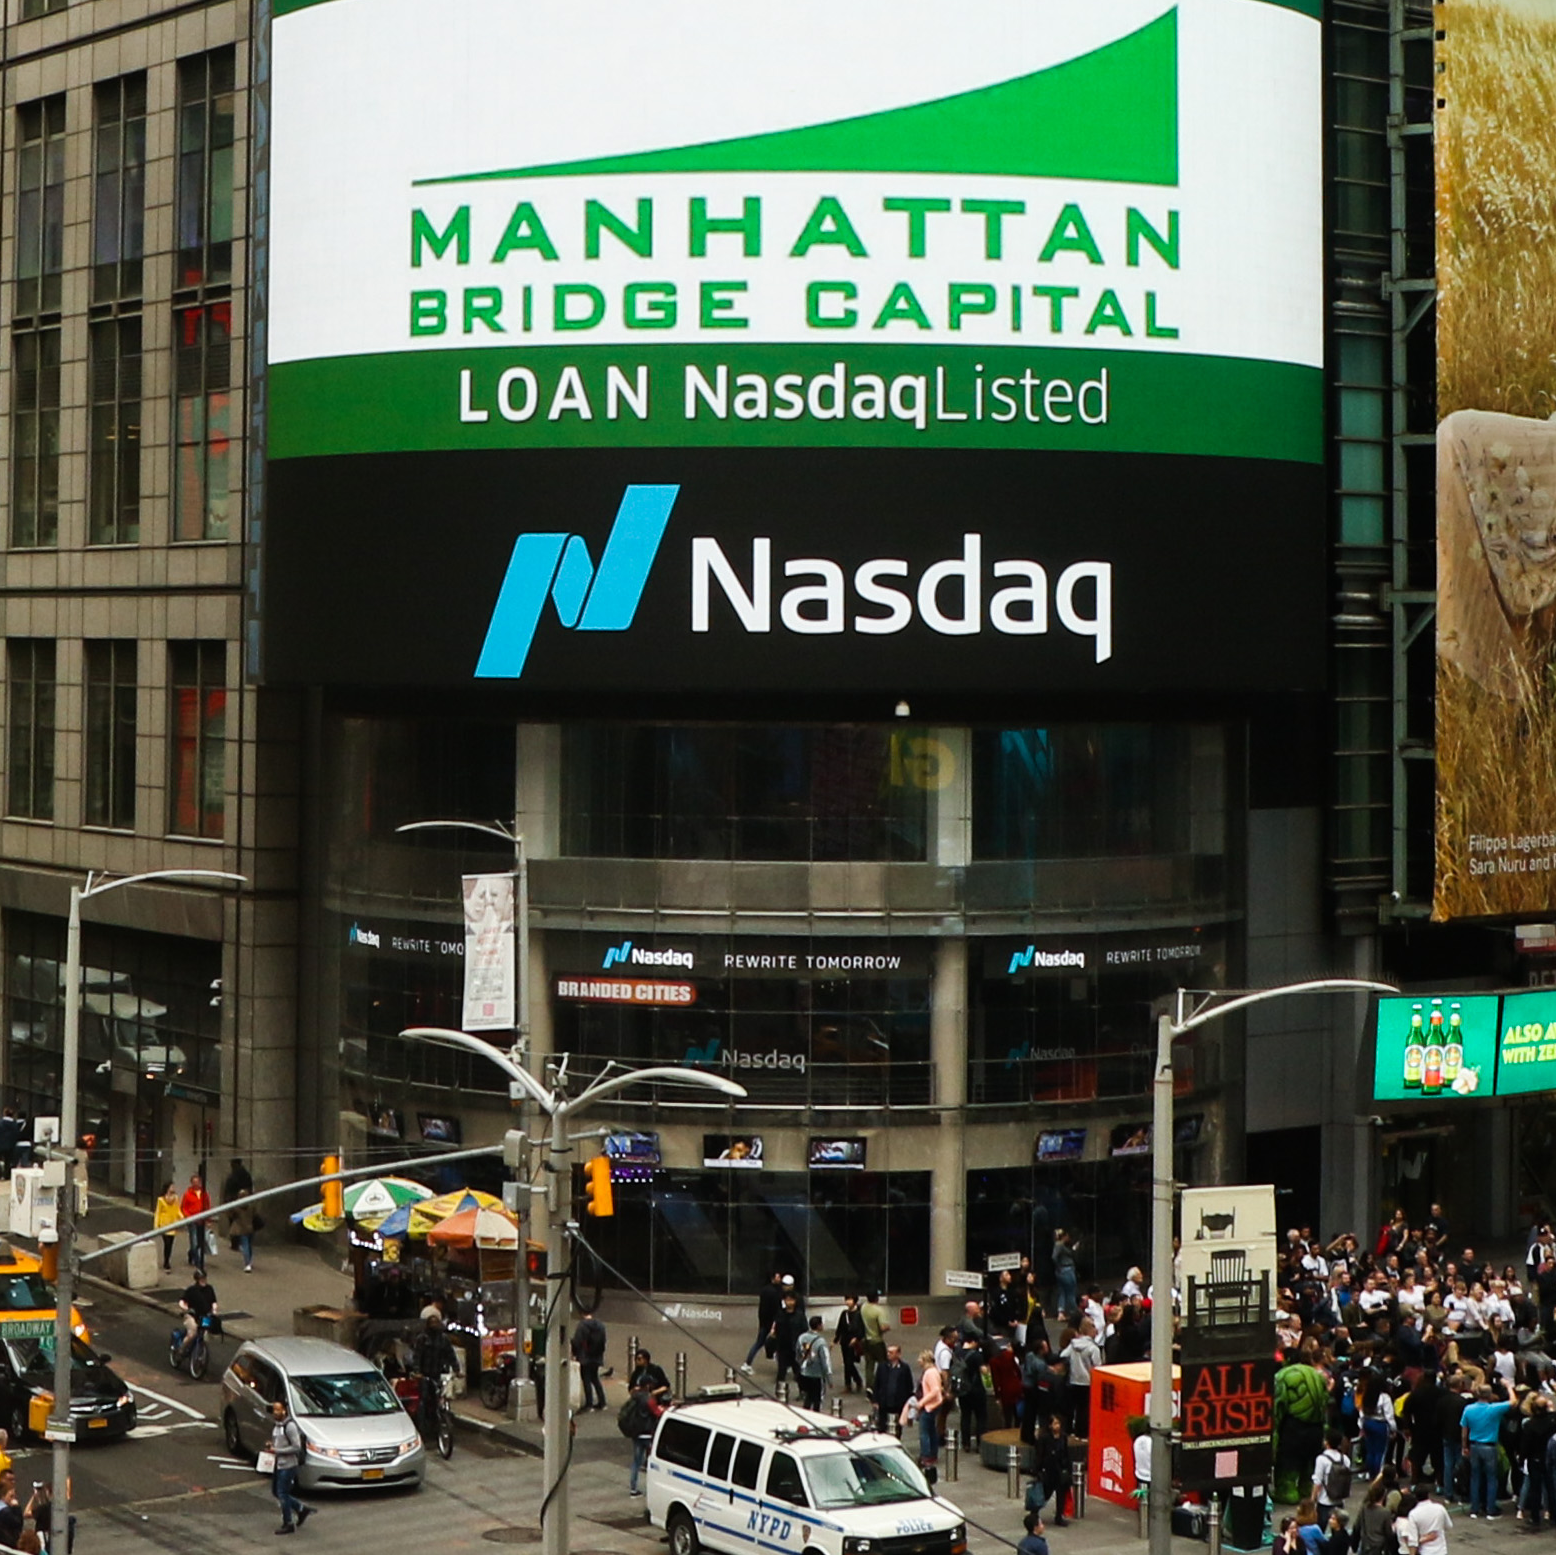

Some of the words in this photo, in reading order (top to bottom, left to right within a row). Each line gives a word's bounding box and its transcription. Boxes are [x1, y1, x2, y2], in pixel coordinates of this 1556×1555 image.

[409, 196, 1181, 270] MANHATTAN
[409, 280, 750, 338] BRIDGE
[805, 280, 1180, 339] CAPITAL
[459, 365, 649, 423] LOAN
[690, 532, 1113, 663] Nasdaq
[1468, 834, 1507, 855] Filippa
[1469, 857, 1496, 876] Sara
[1498, 856, 1527, 873] Nuru
[1529, 854, 1549, 871] and
[436, 939, 464, 956] TOMO
[632, 948, 694, 970] Nasdaq
[725, 954, 797, 969] REWRITE
[806, 955, 901, 970] TOMORROW
[1035, 950, 1085, 969] Nasdaq
[1106, 949, 1152, 964] REWRITE
[558, 980, 632, 1000] BRANDED
[635, 983, 692, 1002] CITIES
[1503, 1025, 1542, 1045] ALSO
[721, 1048, 806, 1074] Nasdaq
[1502, 1046, 1536, 1064] WITH
[1, 1322, 51, 1336] BROADWAY
[1189, 1363, 1266, 1400] ALL
[1183, 1396, 1273, 1436] RISE
[747, 1510, 792, 1541] NYPD
[896, 1523, 934, 1534] POLICE
